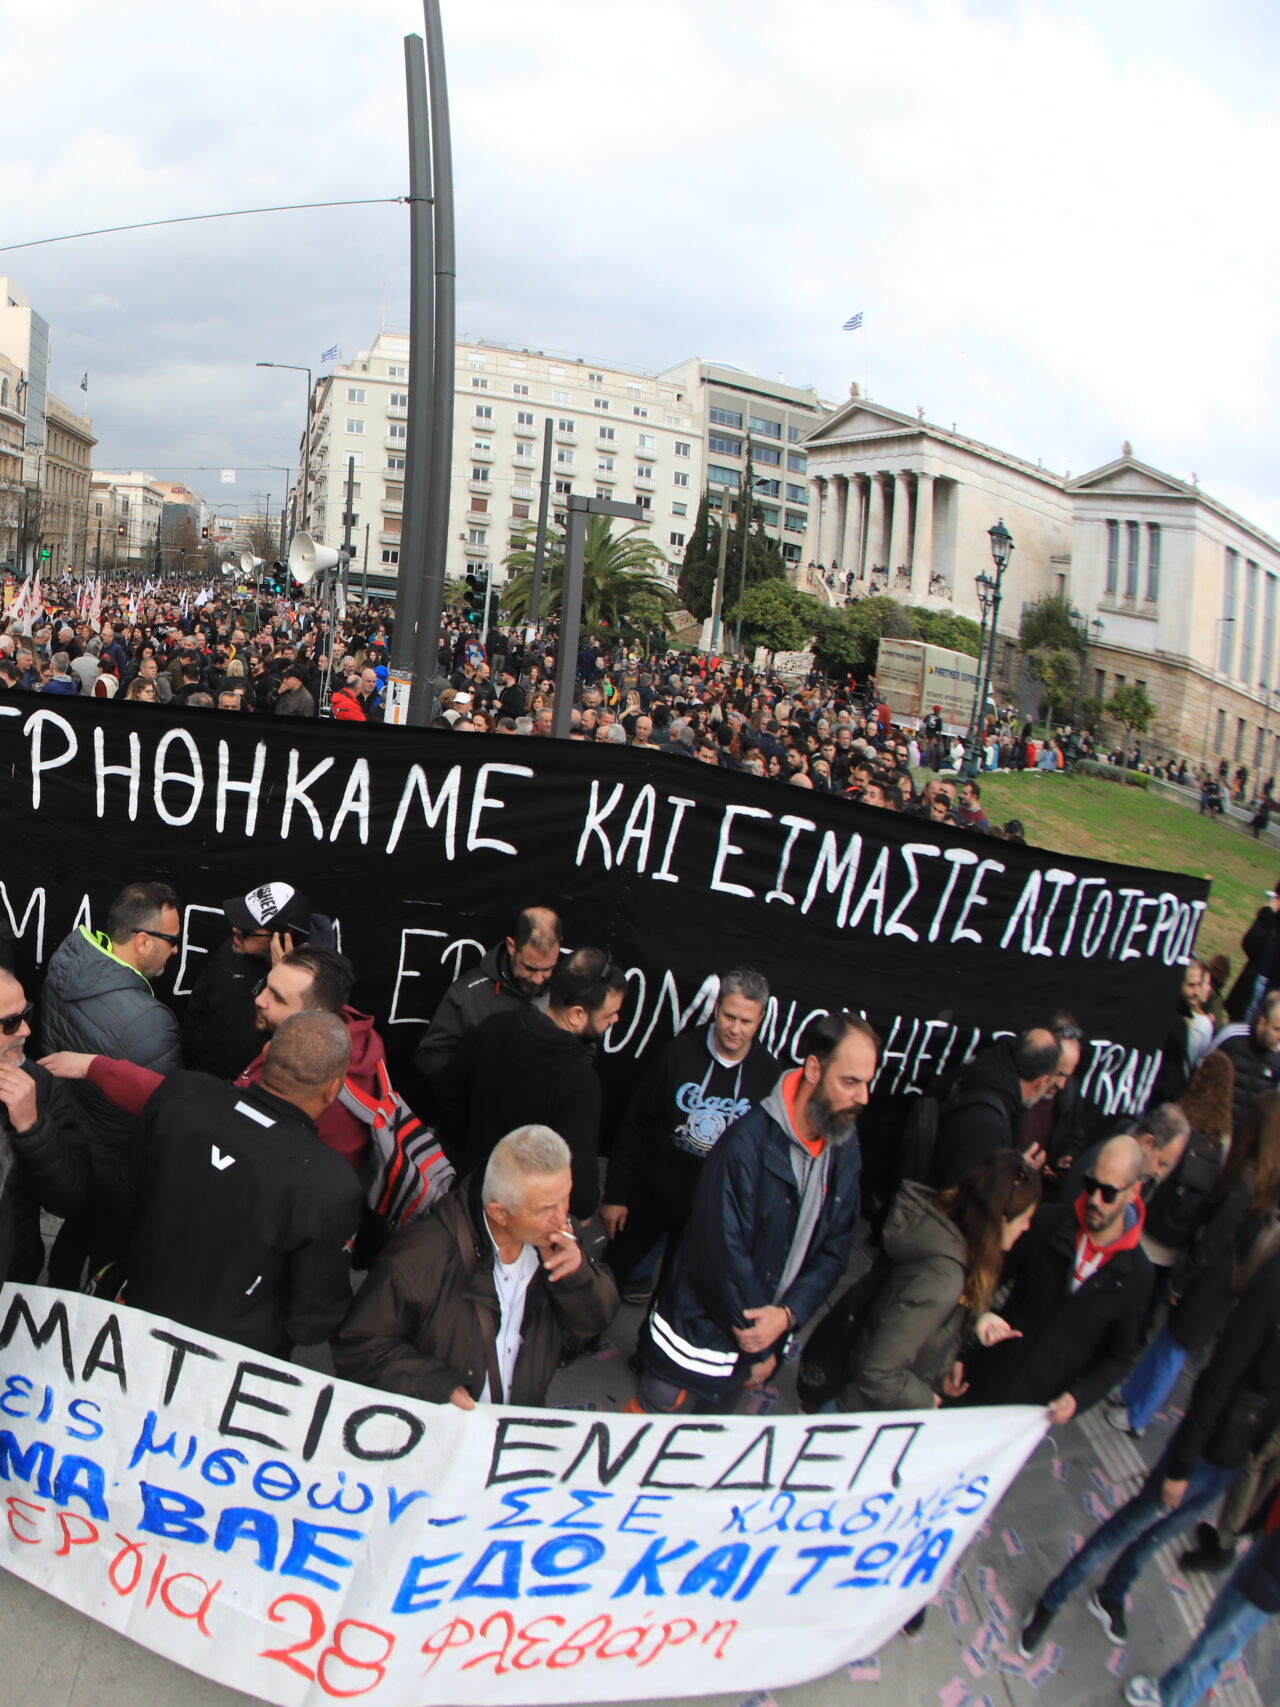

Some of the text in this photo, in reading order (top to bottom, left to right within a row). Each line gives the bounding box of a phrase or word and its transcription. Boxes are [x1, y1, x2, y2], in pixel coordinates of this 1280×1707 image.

[575, 780, 696, 883] ΚΑΙ
[710, 804, 1006, 943] ΕΙΜΑΣΤΕ
[1000, 868, 1208, 966] ΛΙΓΟΤΕΡΟΙ
[484, 1417, 926, 1493] ΕΝΕΔΕΠ
[136, 1481, 365, 1592] ΒΑΕ
[391, 1533, 606, 1614] ΕΔΩ
[609, 1537, 781, 1603] ΚΑΙ
[786, 1527, 954, 1596] ΤΩΡΑ
[484, 1485, 674, 1535] ΣΣΕ
[256, 1592, 397, 1698] 28
